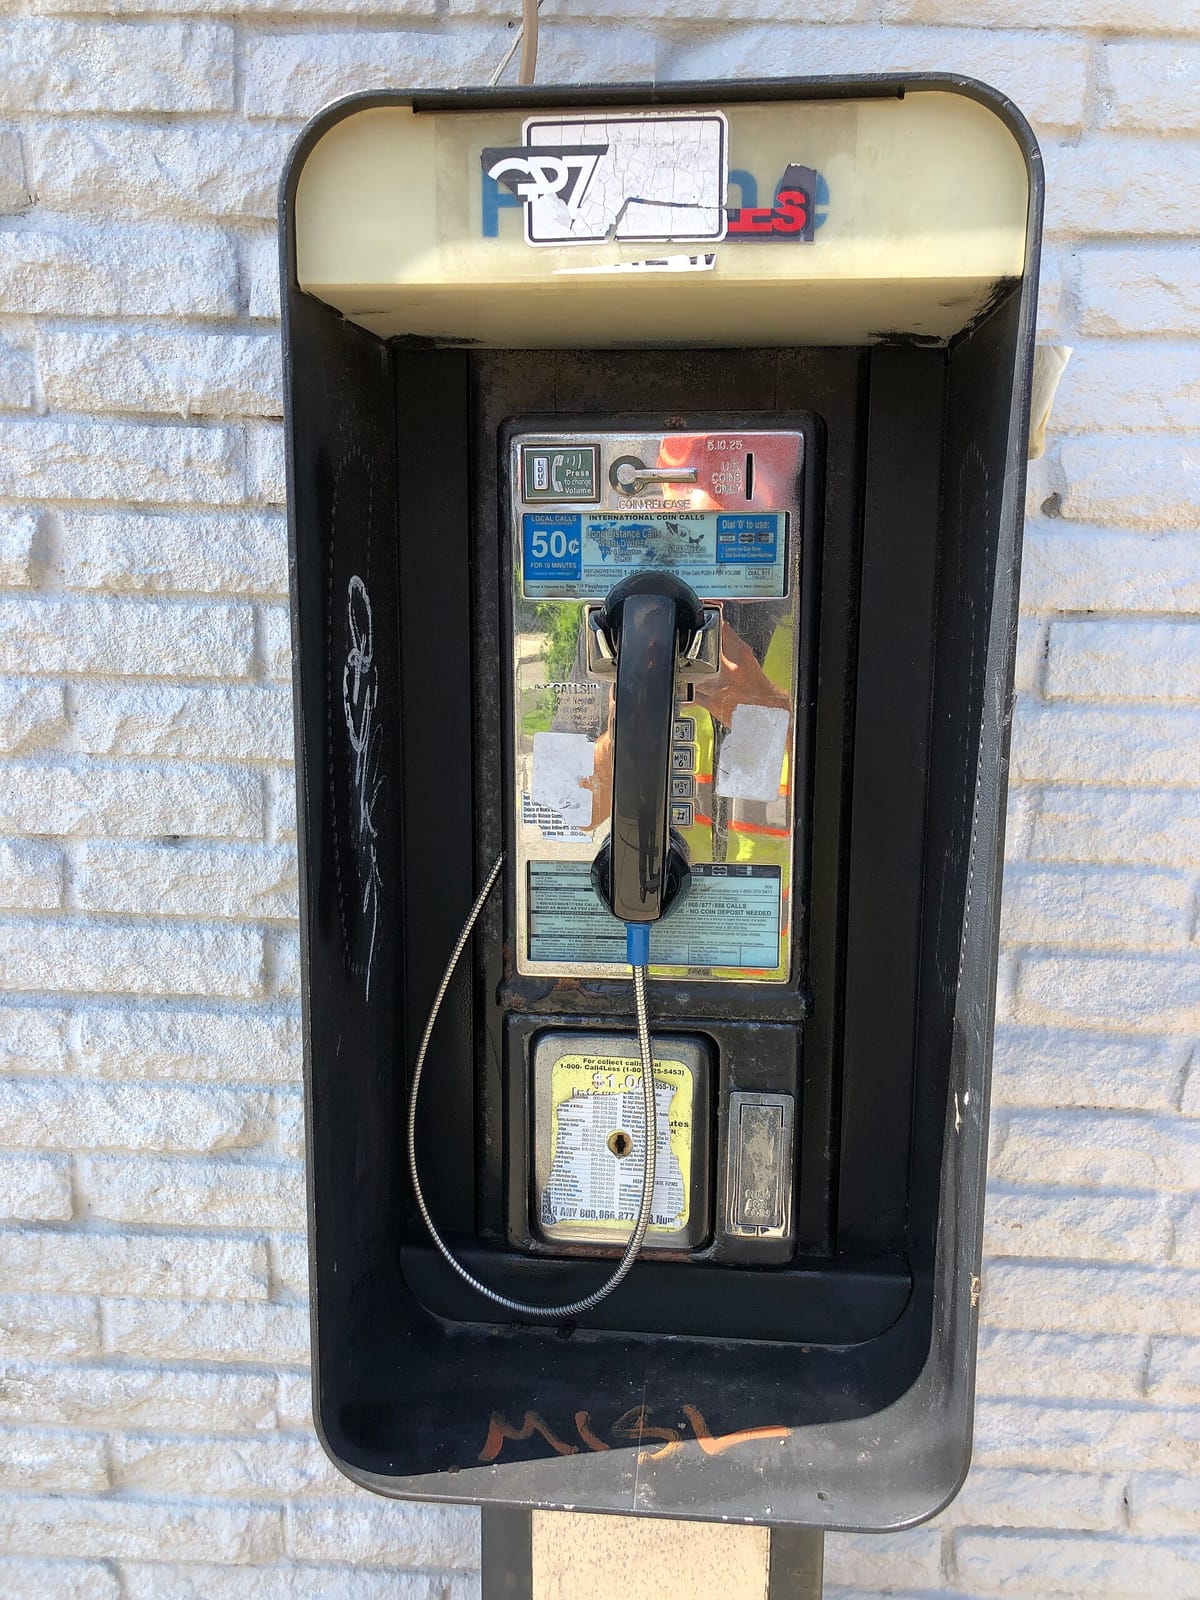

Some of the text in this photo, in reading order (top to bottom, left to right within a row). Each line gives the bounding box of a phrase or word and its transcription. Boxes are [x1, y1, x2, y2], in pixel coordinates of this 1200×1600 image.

[537, 460, 545, 487] LOUD
[566, 469, 590, 477] Press
[711, 472, 743, 484] COINS
[571, 479, 592, 487] change
[714, 484, 742, 495] ONLY
[619, 499, 691, 511] COIN RELEASE
[722, 520, 736, 529] Dial
[746, 520, 753, 529] to
[754, 521, 770, 529] use:
[586, 527, 662, 540] Long Distance Calls
[532, 530, 580, 558] 50¢
[679, 731, 685, 739] 3
[678, 759, 684, 767] 6
[584, 1064, 621, 1072] Call4Less
[560, 1207, 577, 1217] ANY
